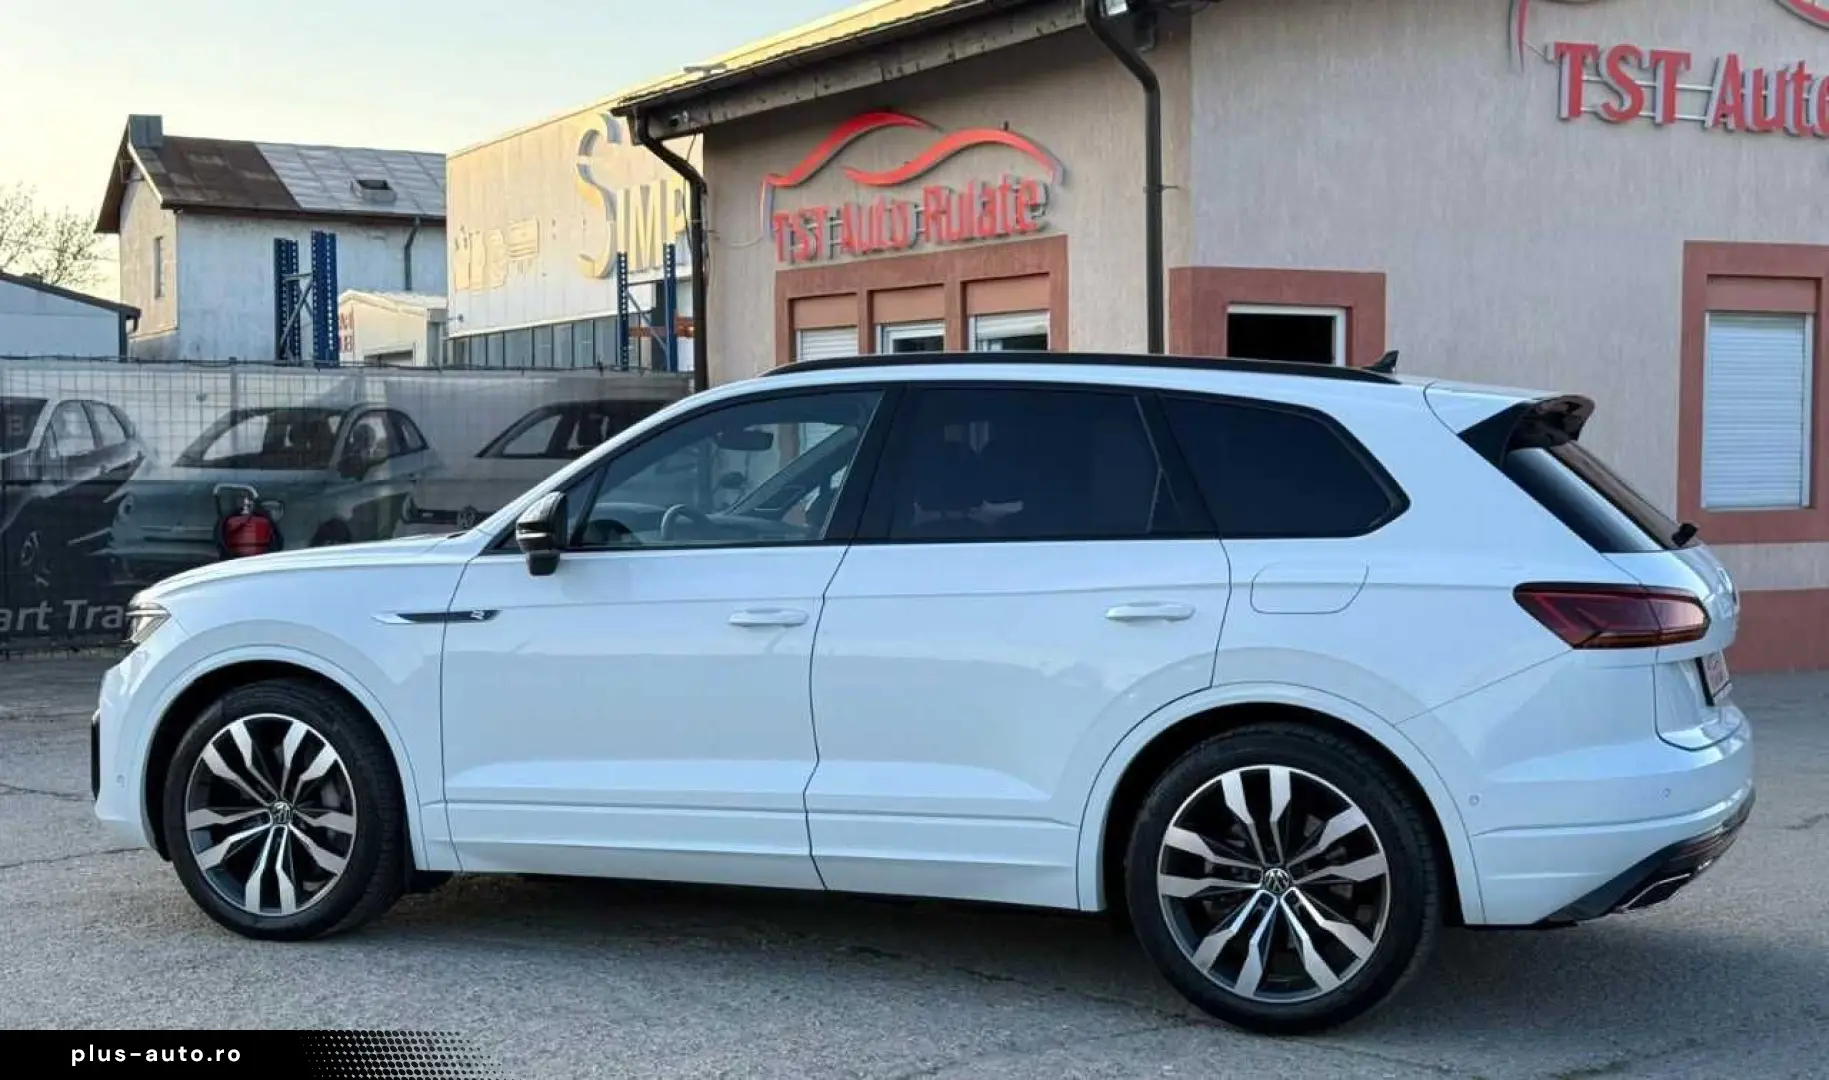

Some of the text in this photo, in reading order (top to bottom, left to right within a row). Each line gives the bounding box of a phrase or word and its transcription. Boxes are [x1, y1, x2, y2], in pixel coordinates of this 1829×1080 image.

[1554, 42, 1692, 126] TST
[772, 174, 1050, 263] TST Auto Rulate
